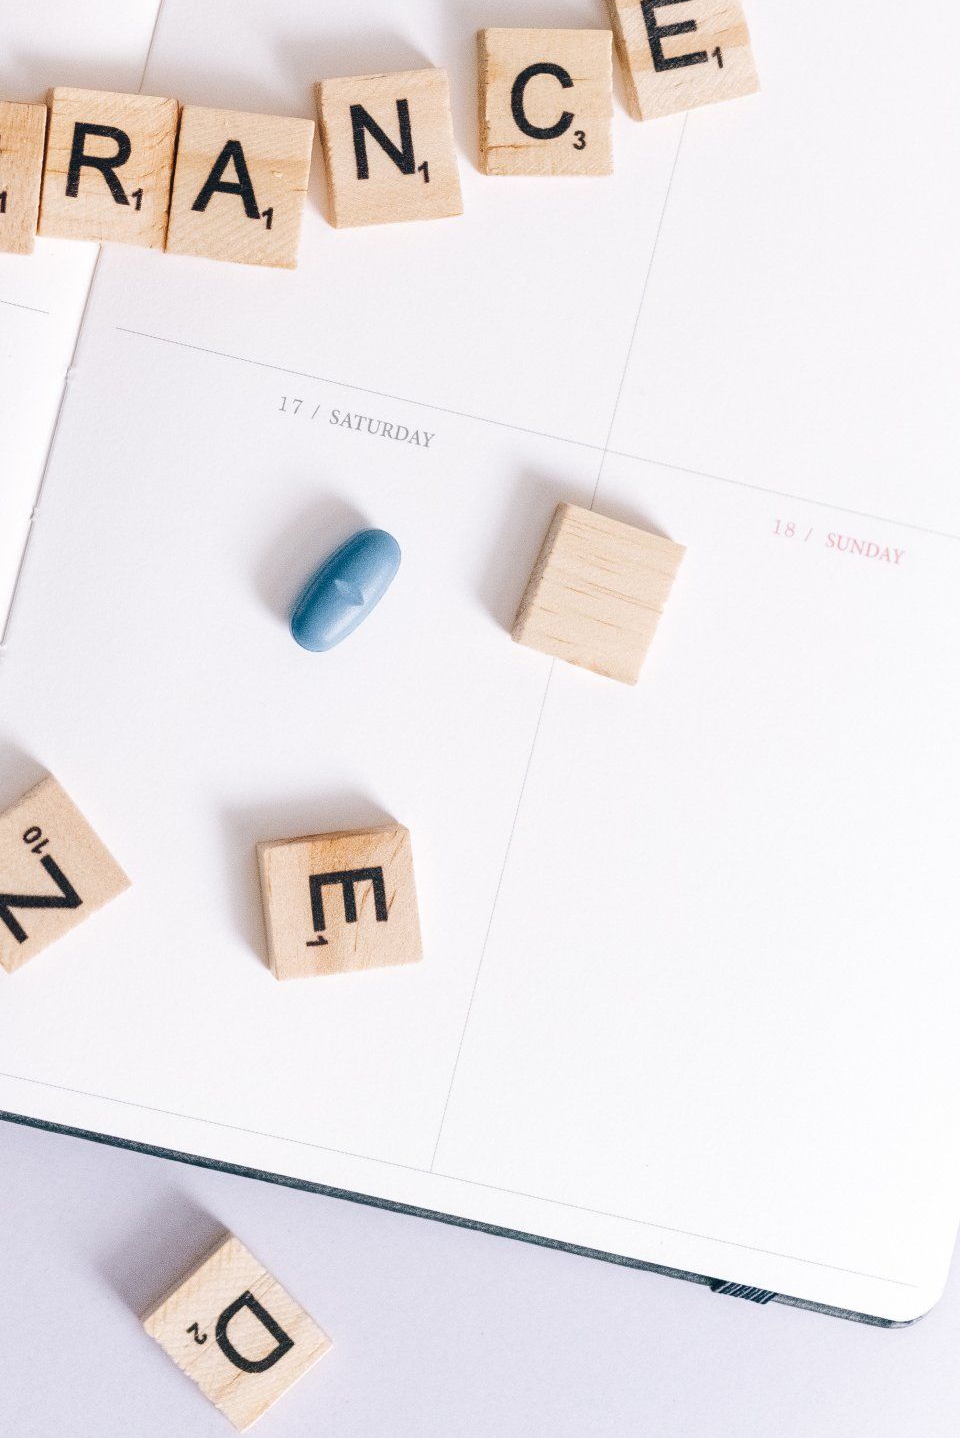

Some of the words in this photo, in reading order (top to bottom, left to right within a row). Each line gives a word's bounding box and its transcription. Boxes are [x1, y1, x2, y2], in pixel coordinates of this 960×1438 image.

[278, 396, 304, 415] 17
[329, 409, 435, 448] SATURDAY
[773, 519, 796, 537] 18
[825, 532, 905, 565] SUNDAY
[308, 865, 389, 934] E
[185, 1321, 208, 1345] 2
[215, 1289, 295, 1374] D
